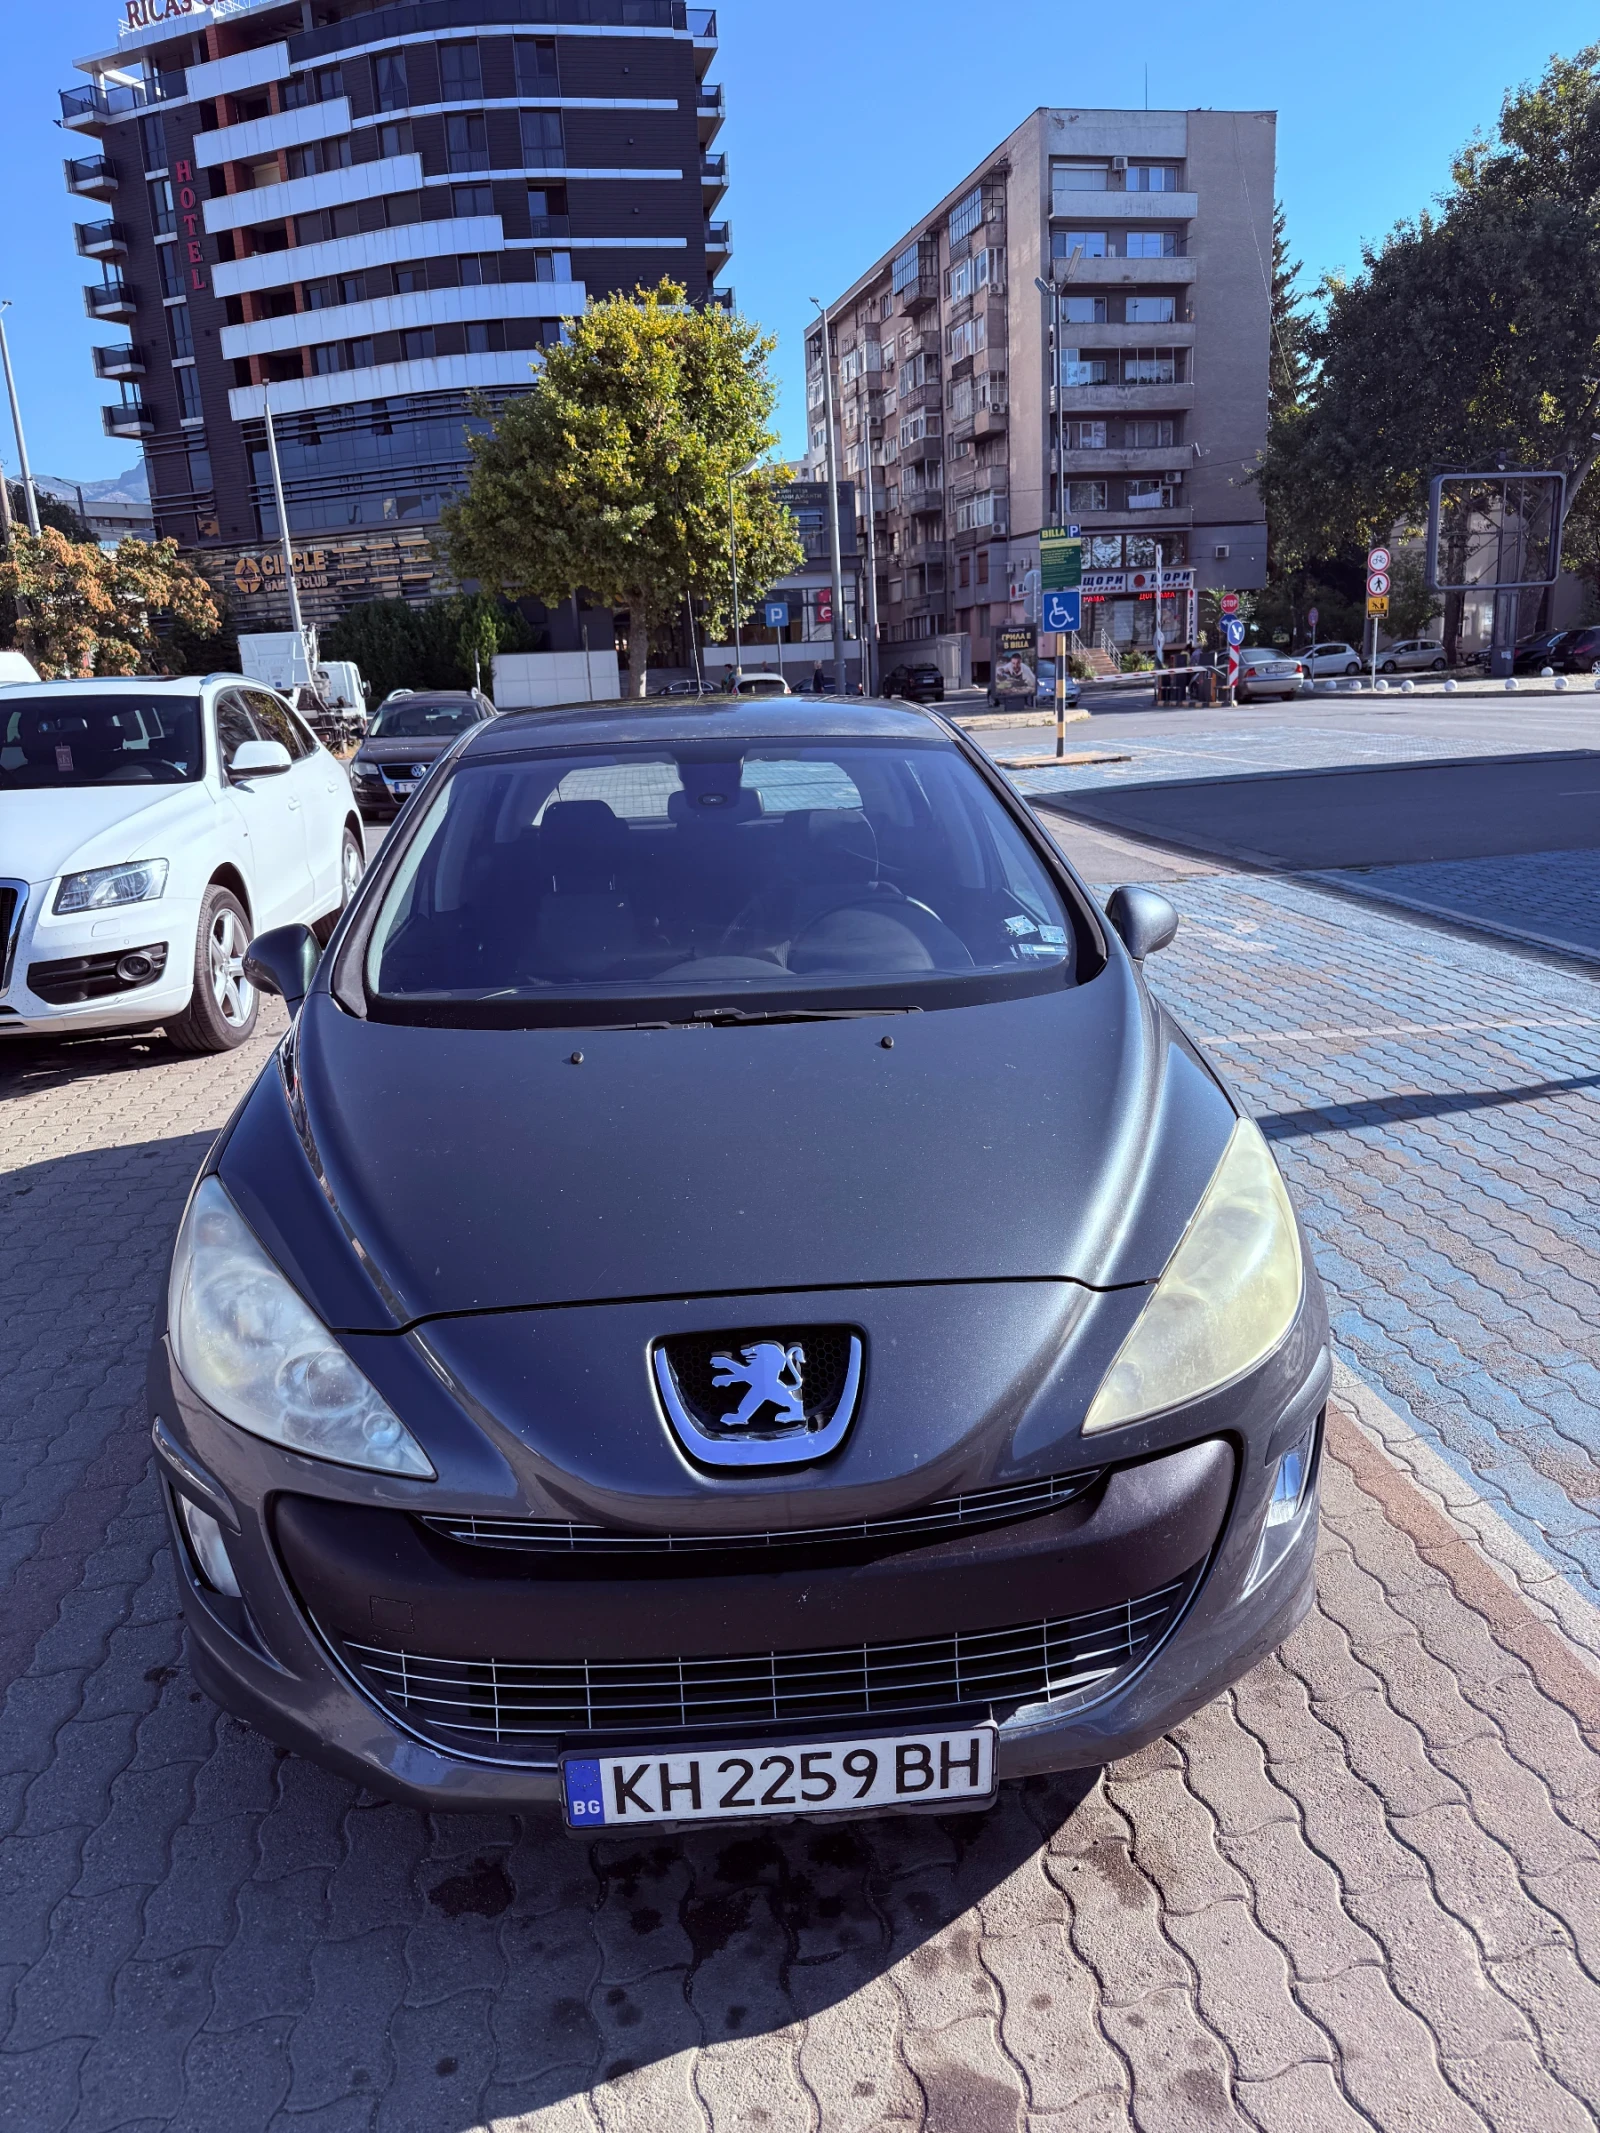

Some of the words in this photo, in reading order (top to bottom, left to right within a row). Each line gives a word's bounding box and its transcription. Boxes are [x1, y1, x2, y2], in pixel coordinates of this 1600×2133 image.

[175, 159, 206, 290] HOTEL
[1041, 528, 1066, 539] BILLA
[1070, 525, 1079, 537] P
[302, 575, 329, 589] CLUB
[1082, 575, 1124, 587] ЩОРИ
[1083, 595, 1105, 603] РАМА
[1222, 599, 1237, 608] STOP
[771, 608, 783, 623] P
[1010, 641, 1029, 649] BILLA
[613, 1761, 702, 1815] KH
[717, 1748, 878, 1809] 2259
[895, 1738, 980, 1794] BH
[573, 1800, 600, 1815] BG
